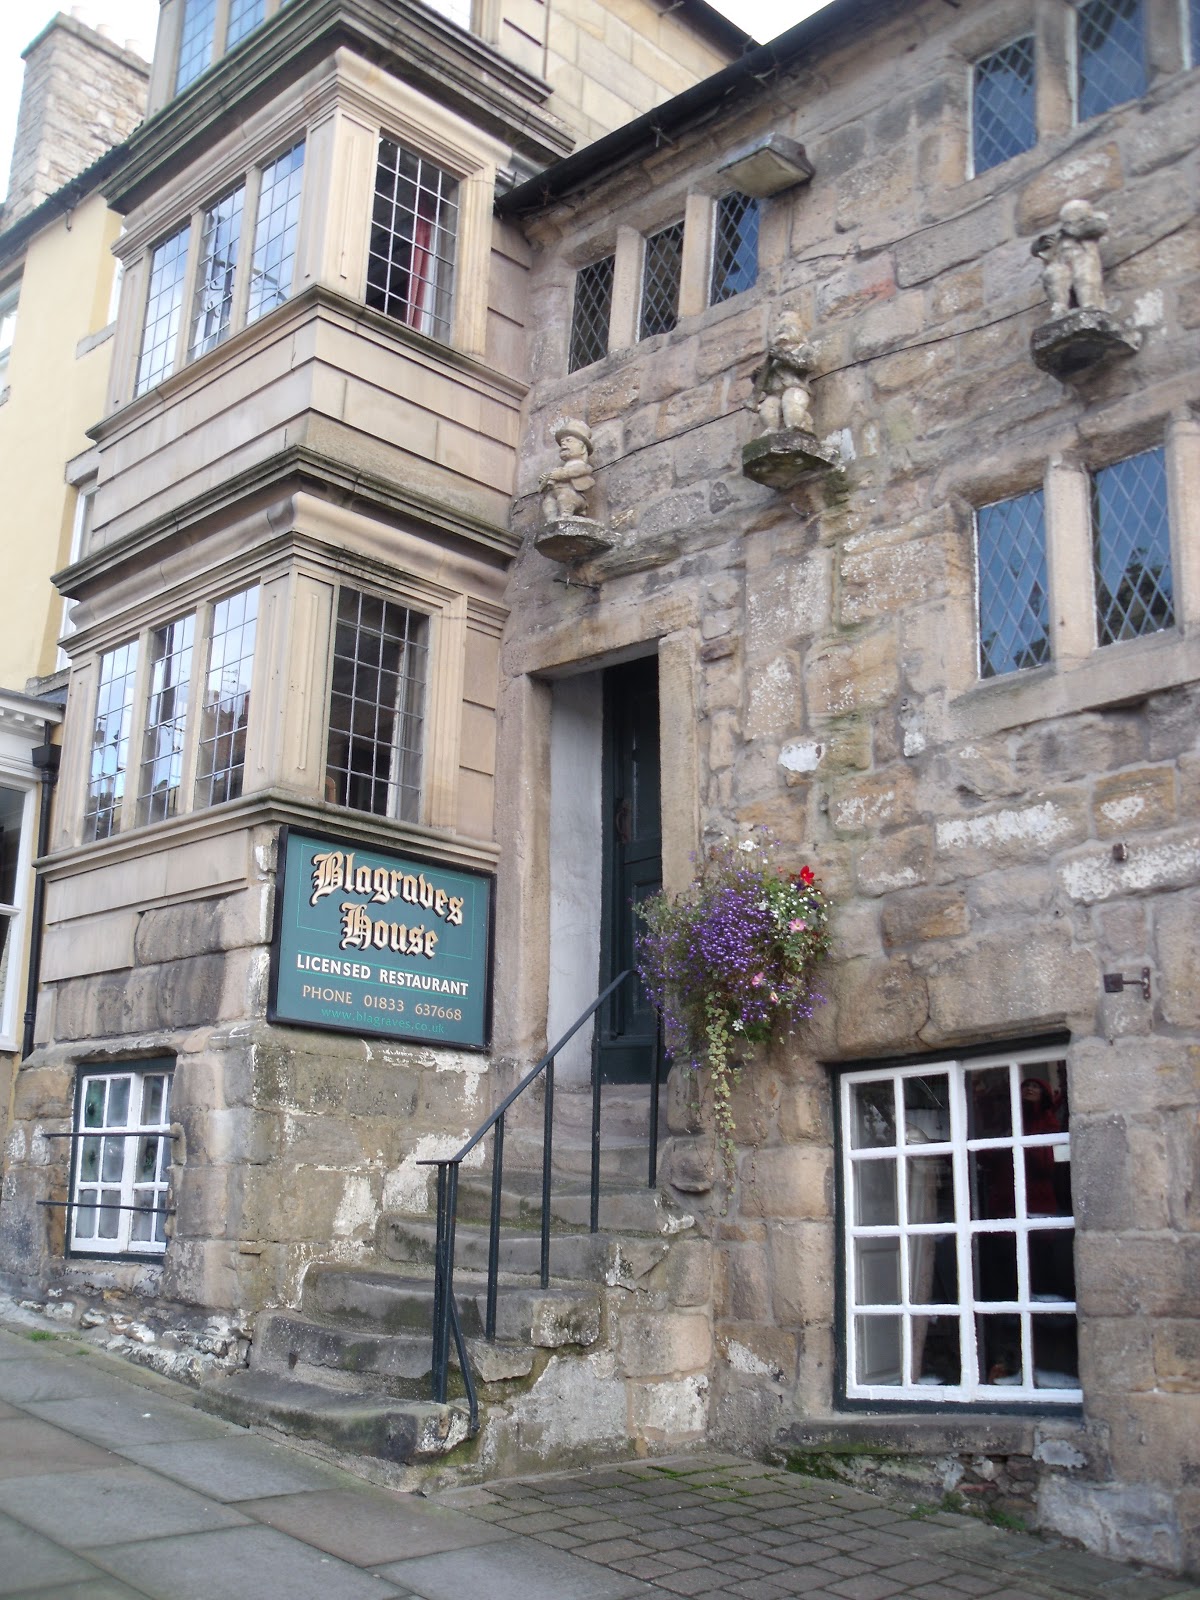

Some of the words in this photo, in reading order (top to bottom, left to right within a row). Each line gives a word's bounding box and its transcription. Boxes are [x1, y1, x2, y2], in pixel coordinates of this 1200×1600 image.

[310, 850, 464, 926] Blagraves
[339, 902, 439, 960] House
[297, 954, 371, 979] LICENSED
[379, 968, 469, 996] RESTAURANT
[302, 985, 353, 1004] PHONE
[363, 994, 405, 1012] 01833
[415, 1002, 462, 1021] 637668
[320, 1007, 445, 1034] www.blagraves.co.uk
